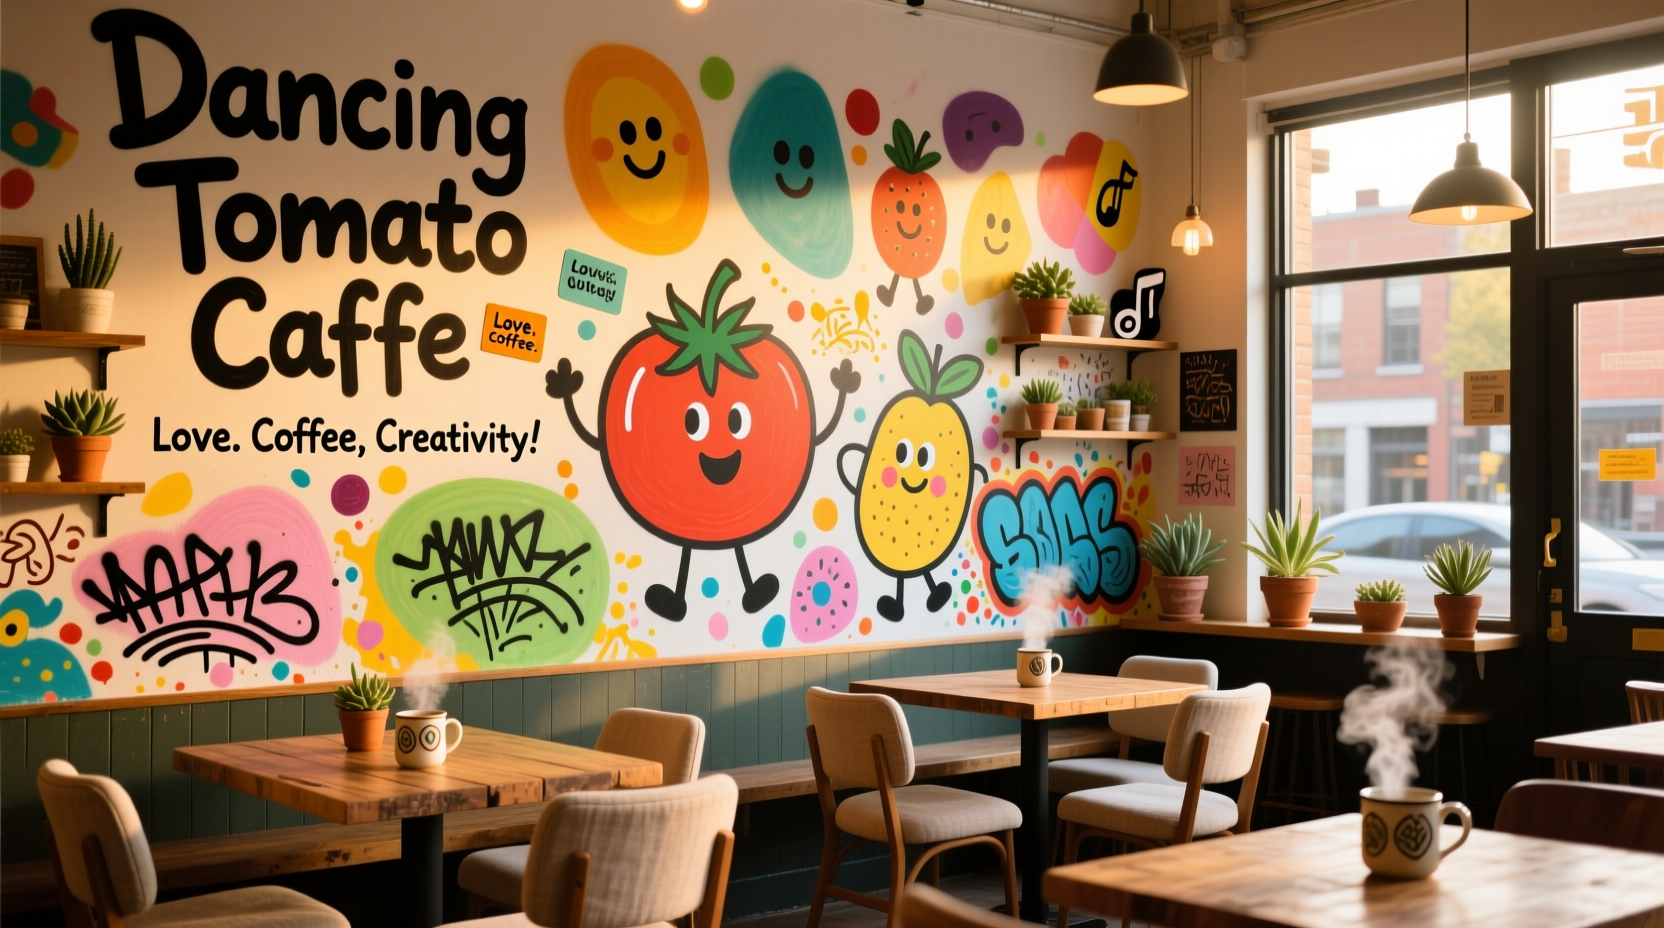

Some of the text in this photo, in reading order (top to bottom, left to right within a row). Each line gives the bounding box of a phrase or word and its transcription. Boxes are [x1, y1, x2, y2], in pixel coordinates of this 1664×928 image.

[89, 7, 528, 197] Dancing
[134, 156, 528, 275] Tomato
[190, 276, 470, 398] Caffe
[493, 311, 536, 337] Love.
[153, 416, 541, 463] Love. Coffee, Creativity!
